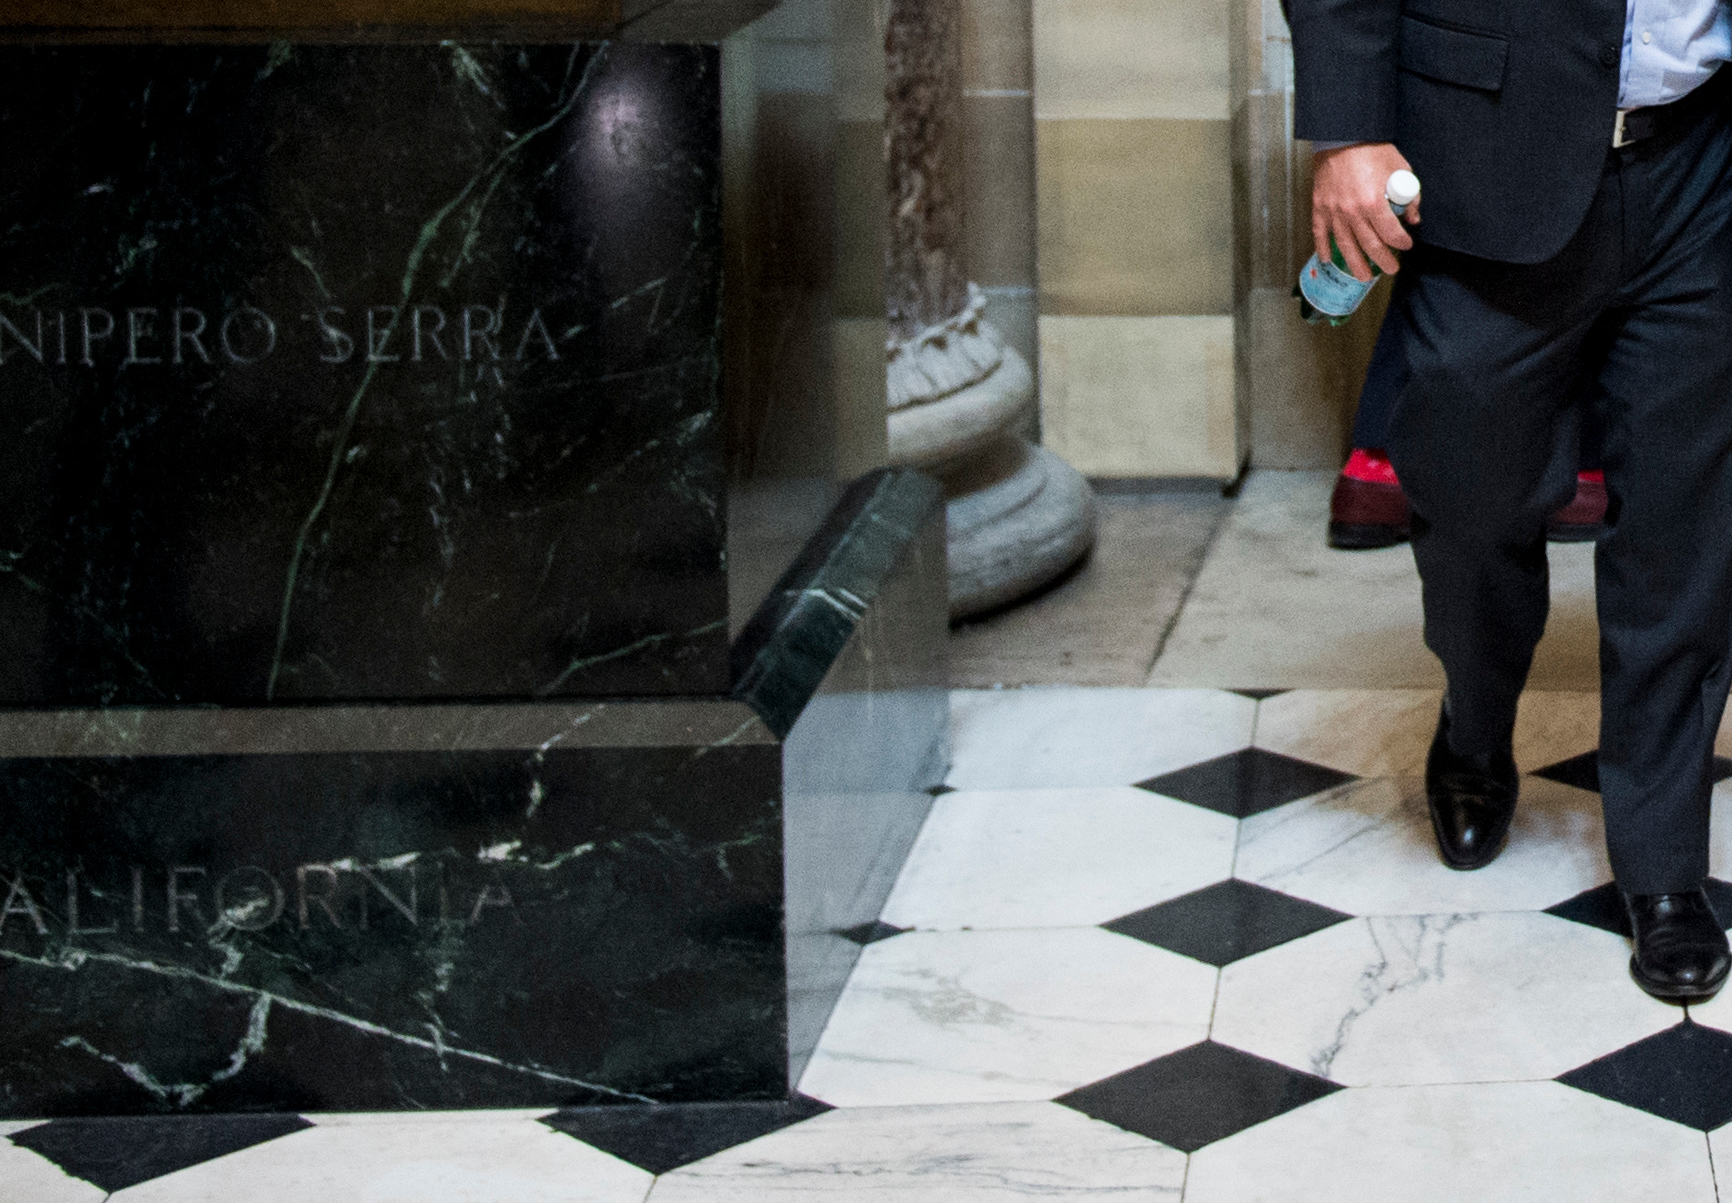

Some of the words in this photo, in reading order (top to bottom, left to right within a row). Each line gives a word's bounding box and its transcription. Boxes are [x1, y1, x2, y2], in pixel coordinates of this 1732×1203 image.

[0, 304, 277, 367] NIPERO
[318, 304, 561, 364] SERRA
[0, 864, 526, 935] ALIFORNIA
